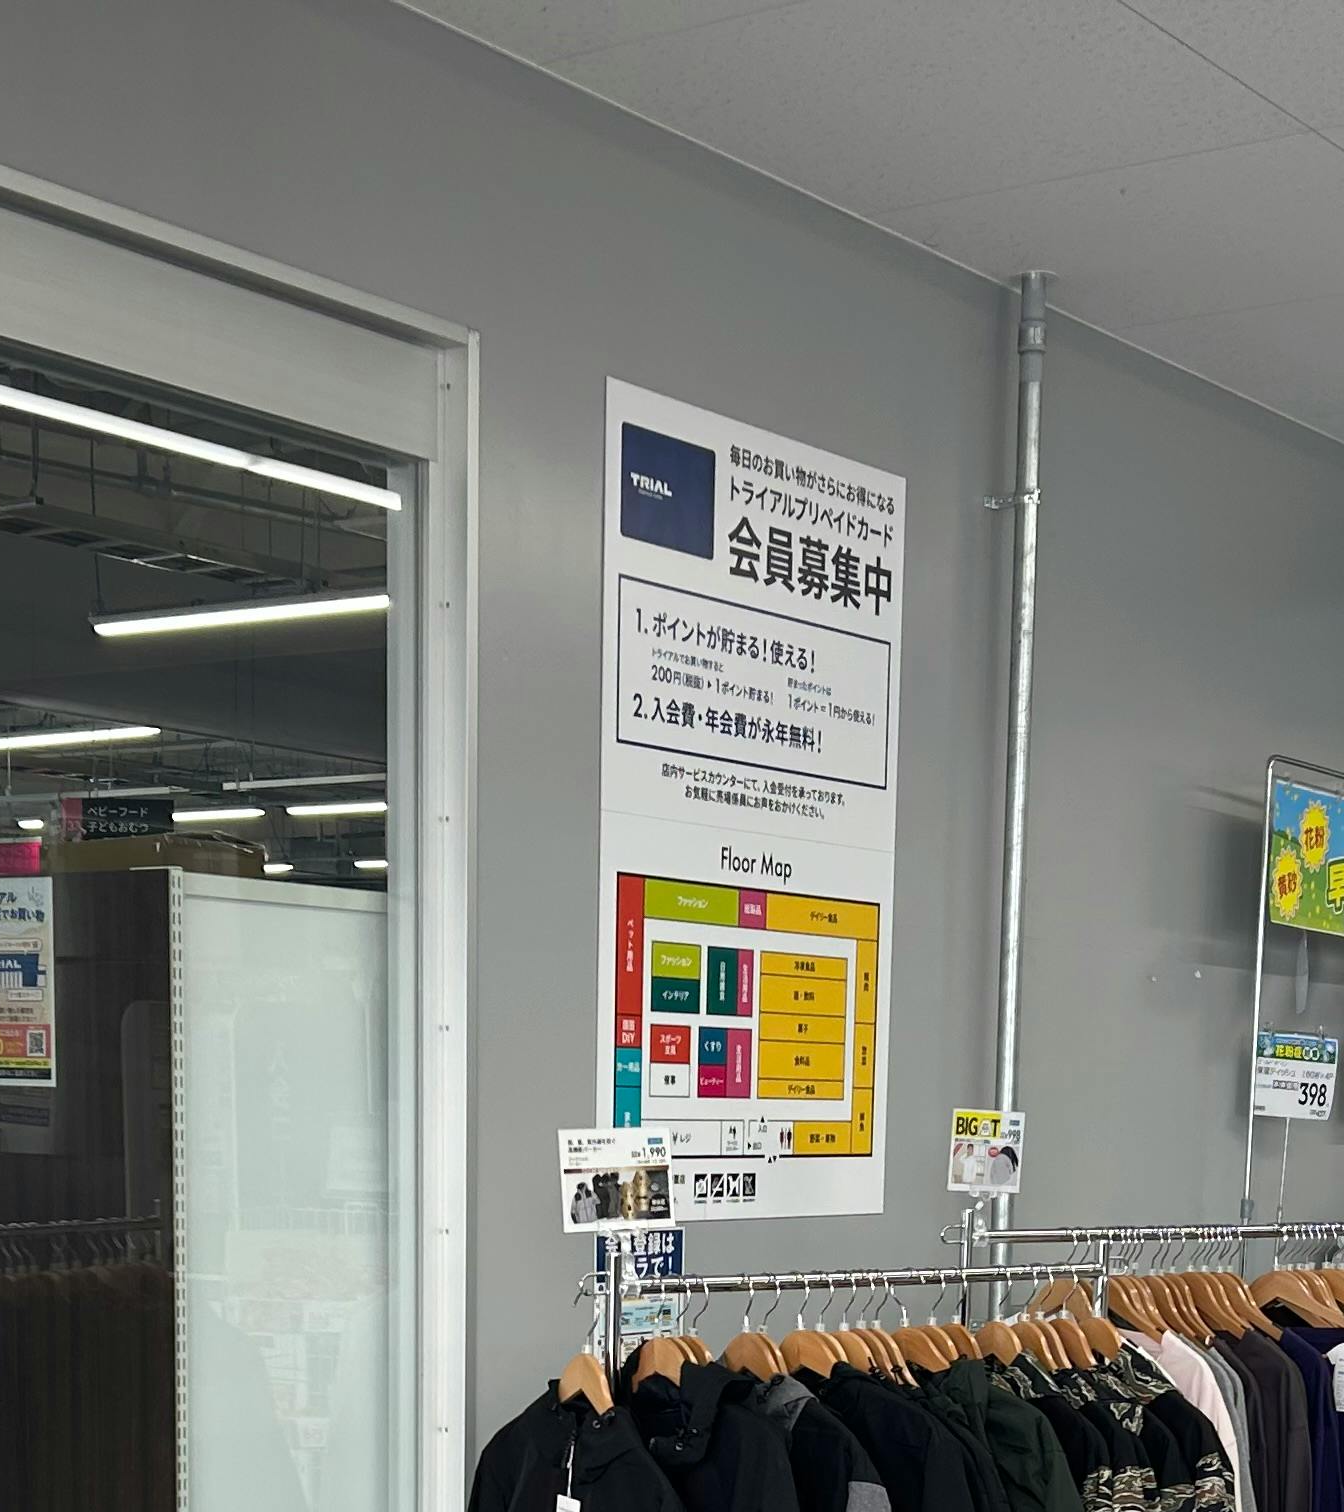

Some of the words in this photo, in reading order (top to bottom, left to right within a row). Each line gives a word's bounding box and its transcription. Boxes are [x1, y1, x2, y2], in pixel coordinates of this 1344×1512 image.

[630, 472, 673, 497] TRIAL
[729, 444, 895, 516] 毎日のお買い物がさらにお得になる
[730, 476, 894, 548] トライアルプリペイドカード
[727, 516, 892, 617] 会員募集中
[88, 805, 149, 818] ベビーフード
[87, 820, 150, 833] 子どもおむつ
[1303, 825, 1326, 851] 花粉
[721, 846, 757, 875] Floor
[760, 850, 792, 886] Map
[1298, 1082, 1327, 1107] 398
[956, 1116, 979, 1136] BIG
